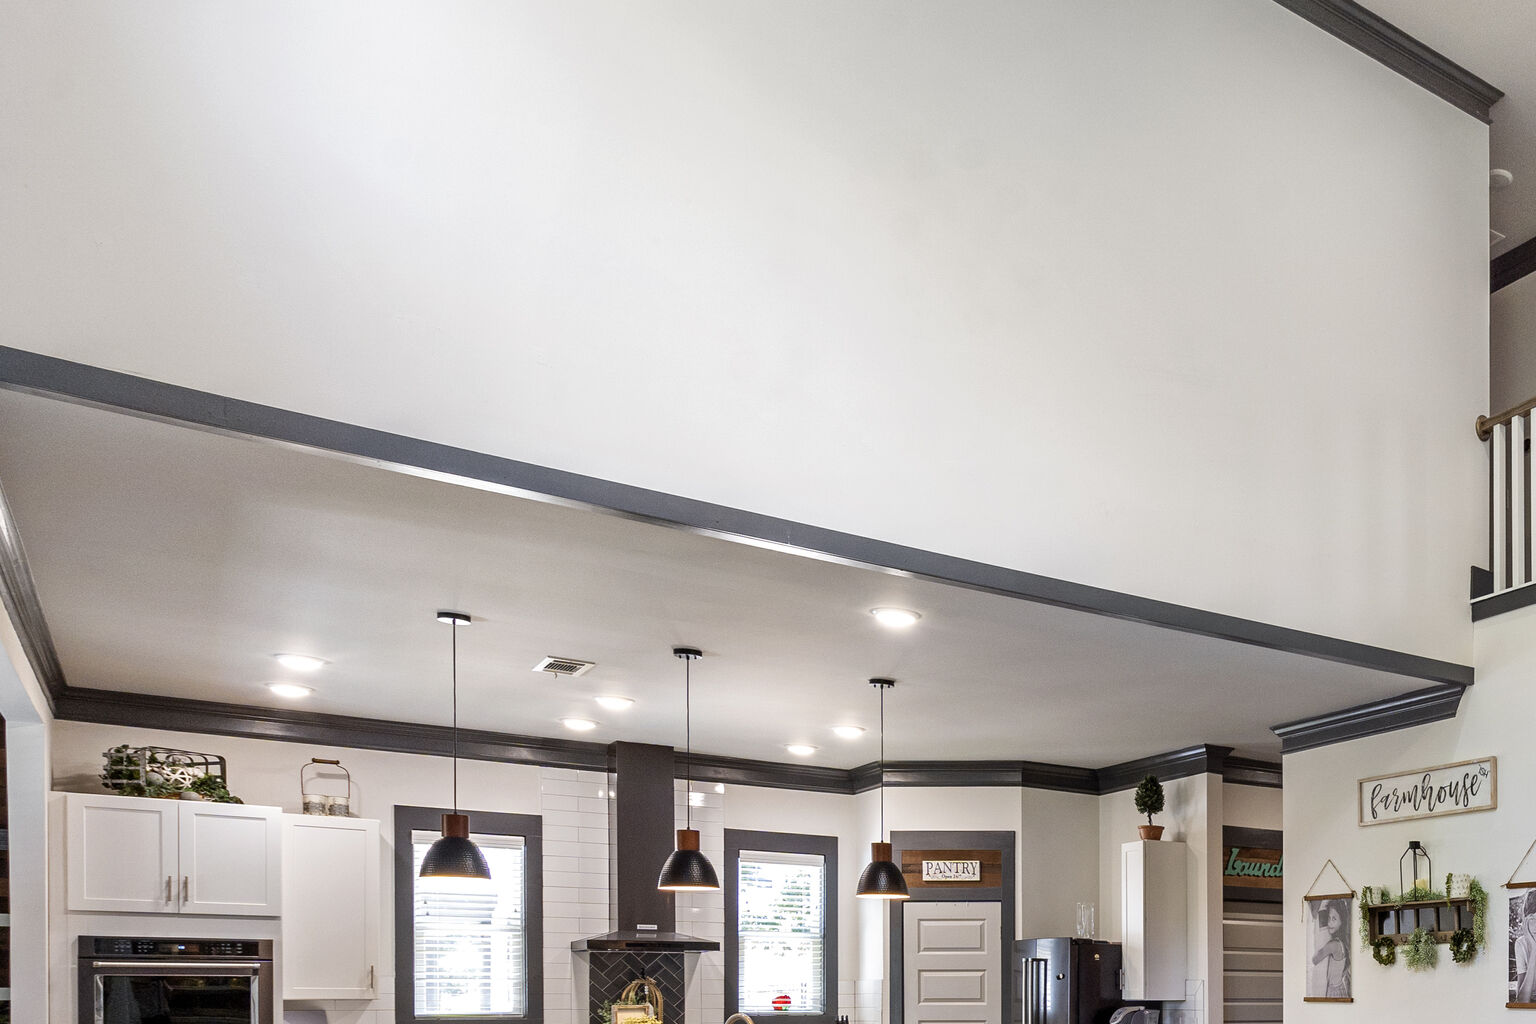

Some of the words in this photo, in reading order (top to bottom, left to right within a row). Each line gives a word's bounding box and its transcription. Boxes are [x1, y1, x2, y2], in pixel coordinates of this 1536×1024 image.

[1370, 773, 1482, 819] farmhouse
[926, 862, 978, 875] PANTRY
[1224, 847, 1283, 877] Laund
